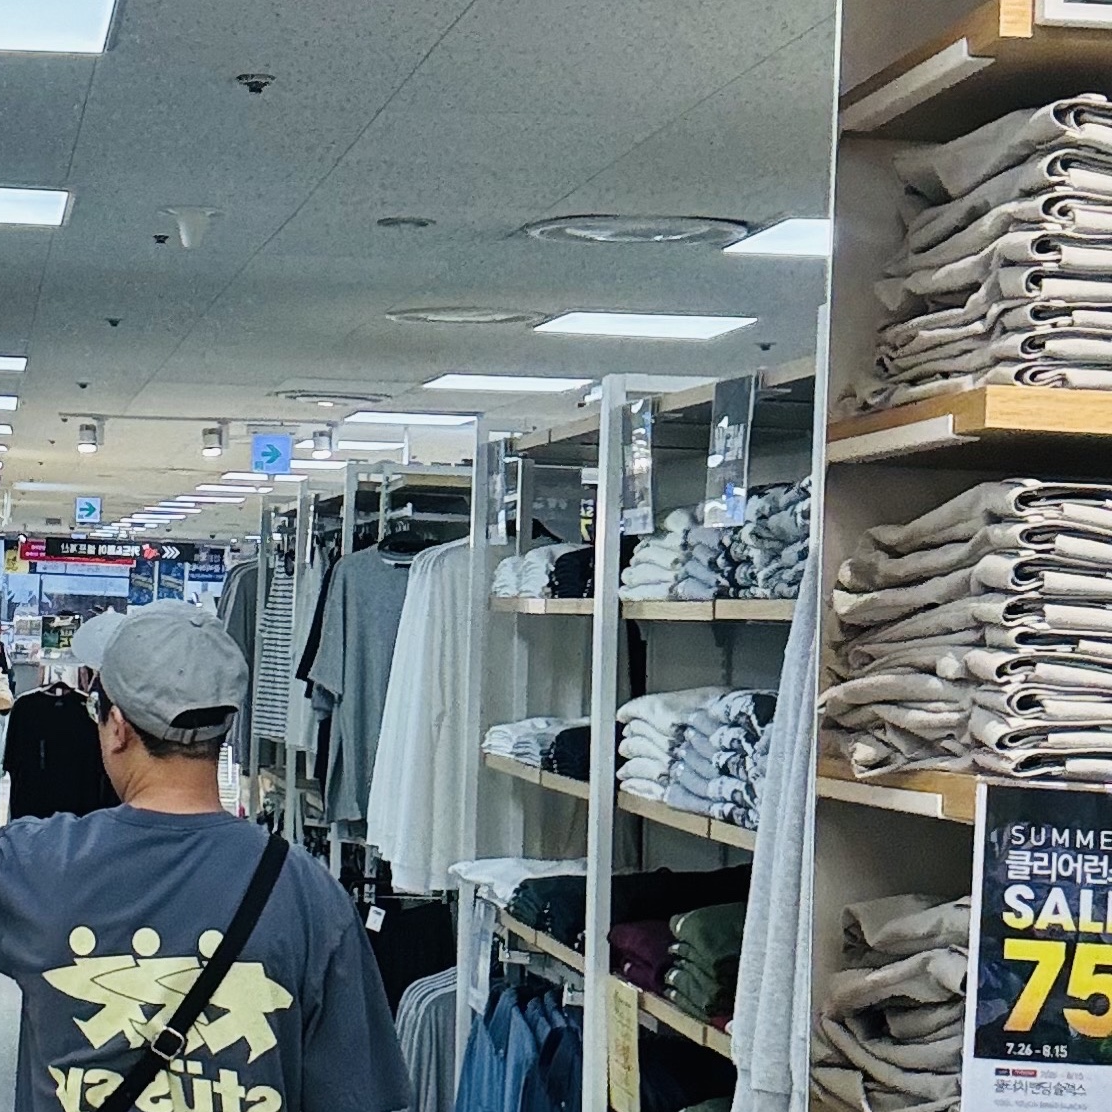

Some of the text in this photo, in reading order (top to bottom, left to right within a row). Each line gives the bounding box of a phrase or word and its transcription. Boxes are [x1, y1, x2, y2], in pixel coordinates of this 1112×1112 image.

[1005, 849, 1112, 885] 클리어런
[1002, 884, 1112, 934] SAL
[1002, 938, 1112, 1039] 75
